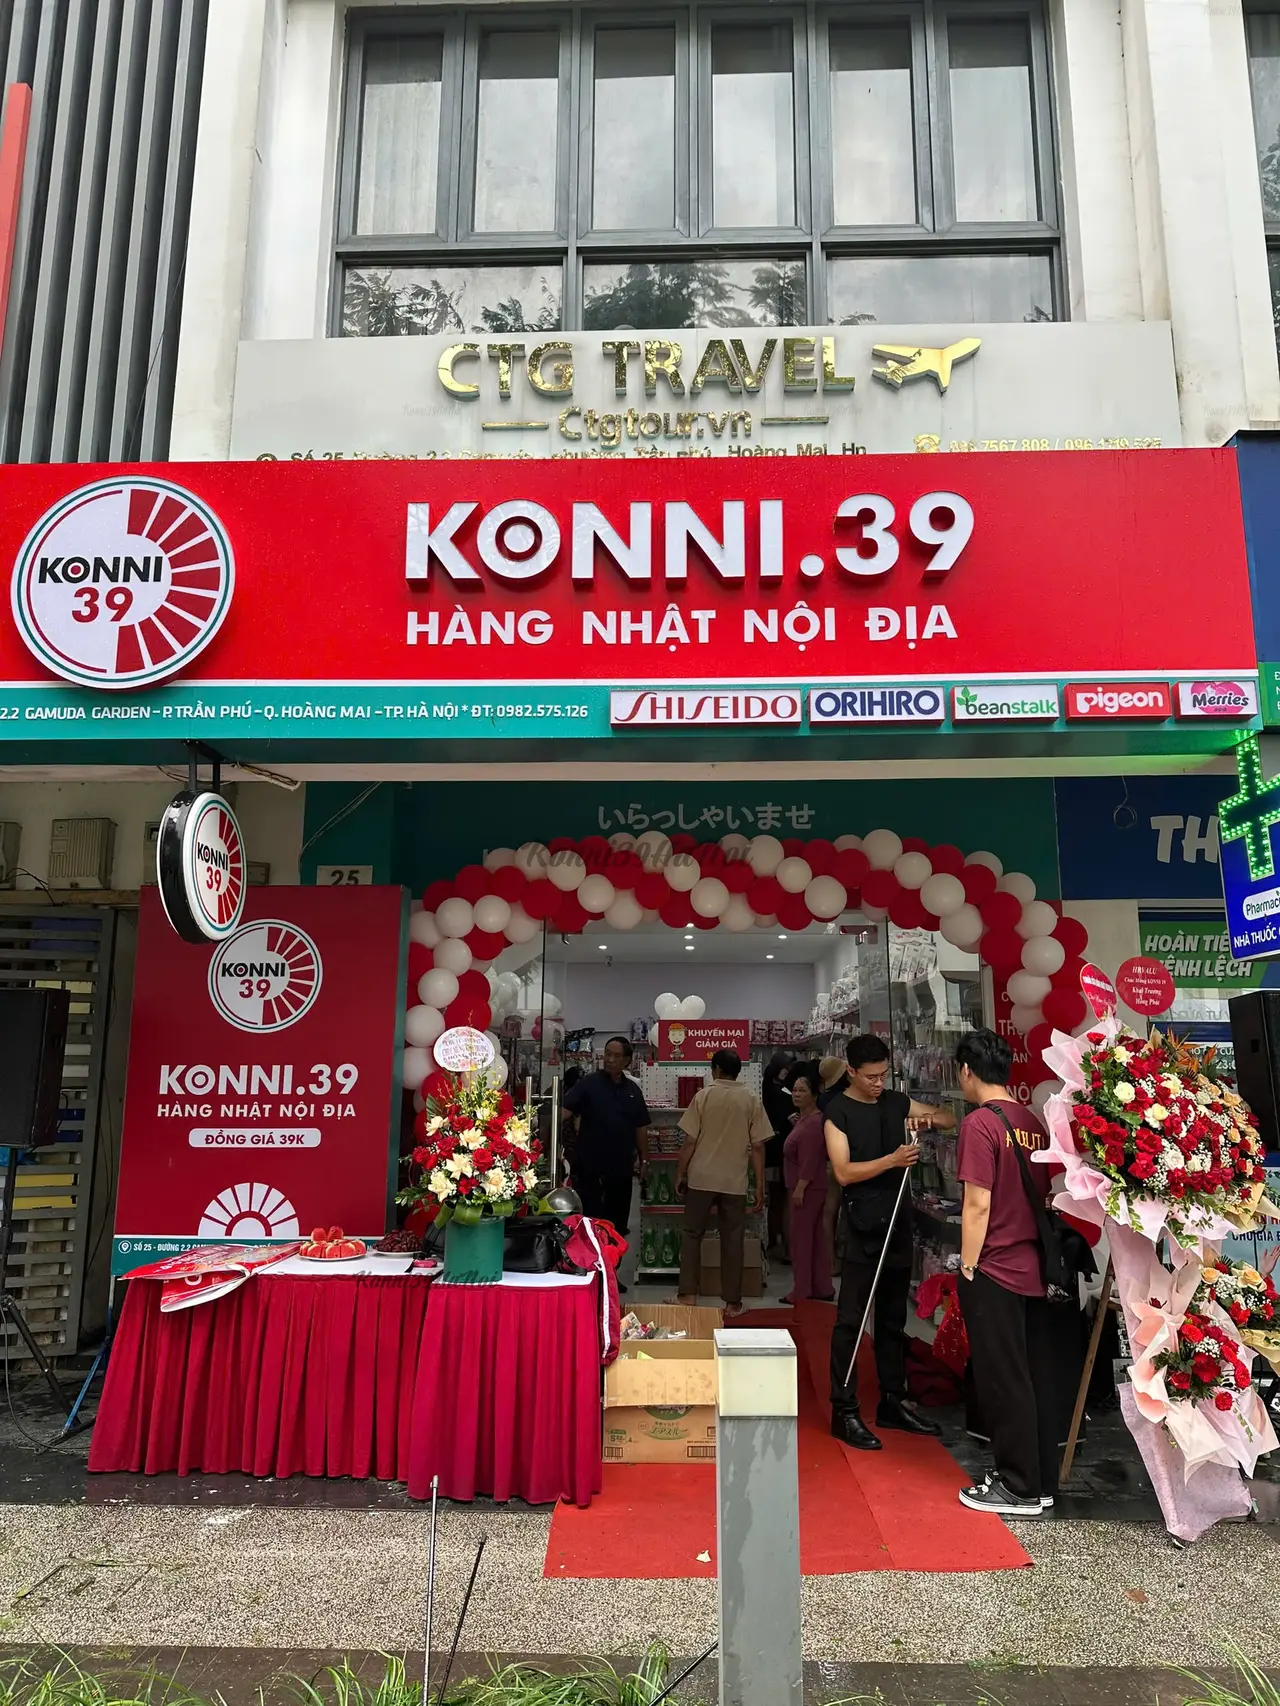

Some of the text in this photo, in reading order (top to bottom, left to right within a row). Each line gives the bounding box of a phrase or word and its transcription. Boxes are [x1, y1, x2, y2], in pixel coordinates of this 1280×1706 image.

[437, 337, 855, 399] CTG TRAVEL
[558, 406, 752, 448] Ctgtour.vn
[405, 490, 975, 583] KONNI.39
[38, 555, 163, 584] KONNI
[71, 586, 134, 623] 39
[407, 601, 959, 652] HÀNG NHẬT NỘI ĐỊA
[25, 706, 86, 720] GAMUDA
[91, 706, 150, 719] GARDEN
[220, 700, 251, 719] PHÚ
[283, 701, 336, 719] HOÀNG
[340, 705, 371, 719] MAI
[407, 701, 428, 718] HÀ
[433, 702, 458, 720] NỘI
[497, 704, 588, 718] 0982.575.126
[614, 691, 798, 722] SHISEIDO
[815, 690, 939, 717] ORIHIRO
[965, 696, 1057, 716] beanstalk
[1077, 686, 1163, 713] pigeon
[1192, 690, 1250, 708] Merries
[598, 802, 815, 830] いらっしゃいませ
[197, 841, 228, 871] KONNI
[206, 866, 222, 892] 39
[330, 869, 360, 885] 25
[1246, 897, 1280, 916] Pharmac
[1144, 930, 1200, 952] HOÀN
[1234, 922, 1277, 948] NHÀ THUỐC
[221, 962, 286, 978] KONNI
[1204, 953, 1253, 981] LỆCH
[238, 978, 271, 999] 39
[688, 1026, 745, 1039] KHUYẾN MẠI
[721, 1039, 737, 1048] GIÁ
[158, 1063, 359, 1095] KONNI.39
[157, 1100, 356, 1121] HÀNG NHẬT NỘI ĐỊA
[205, 1129, 305, 1145] ĐỒNG GIÁ 39K
[133, 1241, 143, 1251] SỐ
[143, 1243, 152, 1251] 25
[180, 1243, 191, 1251] 2.2
